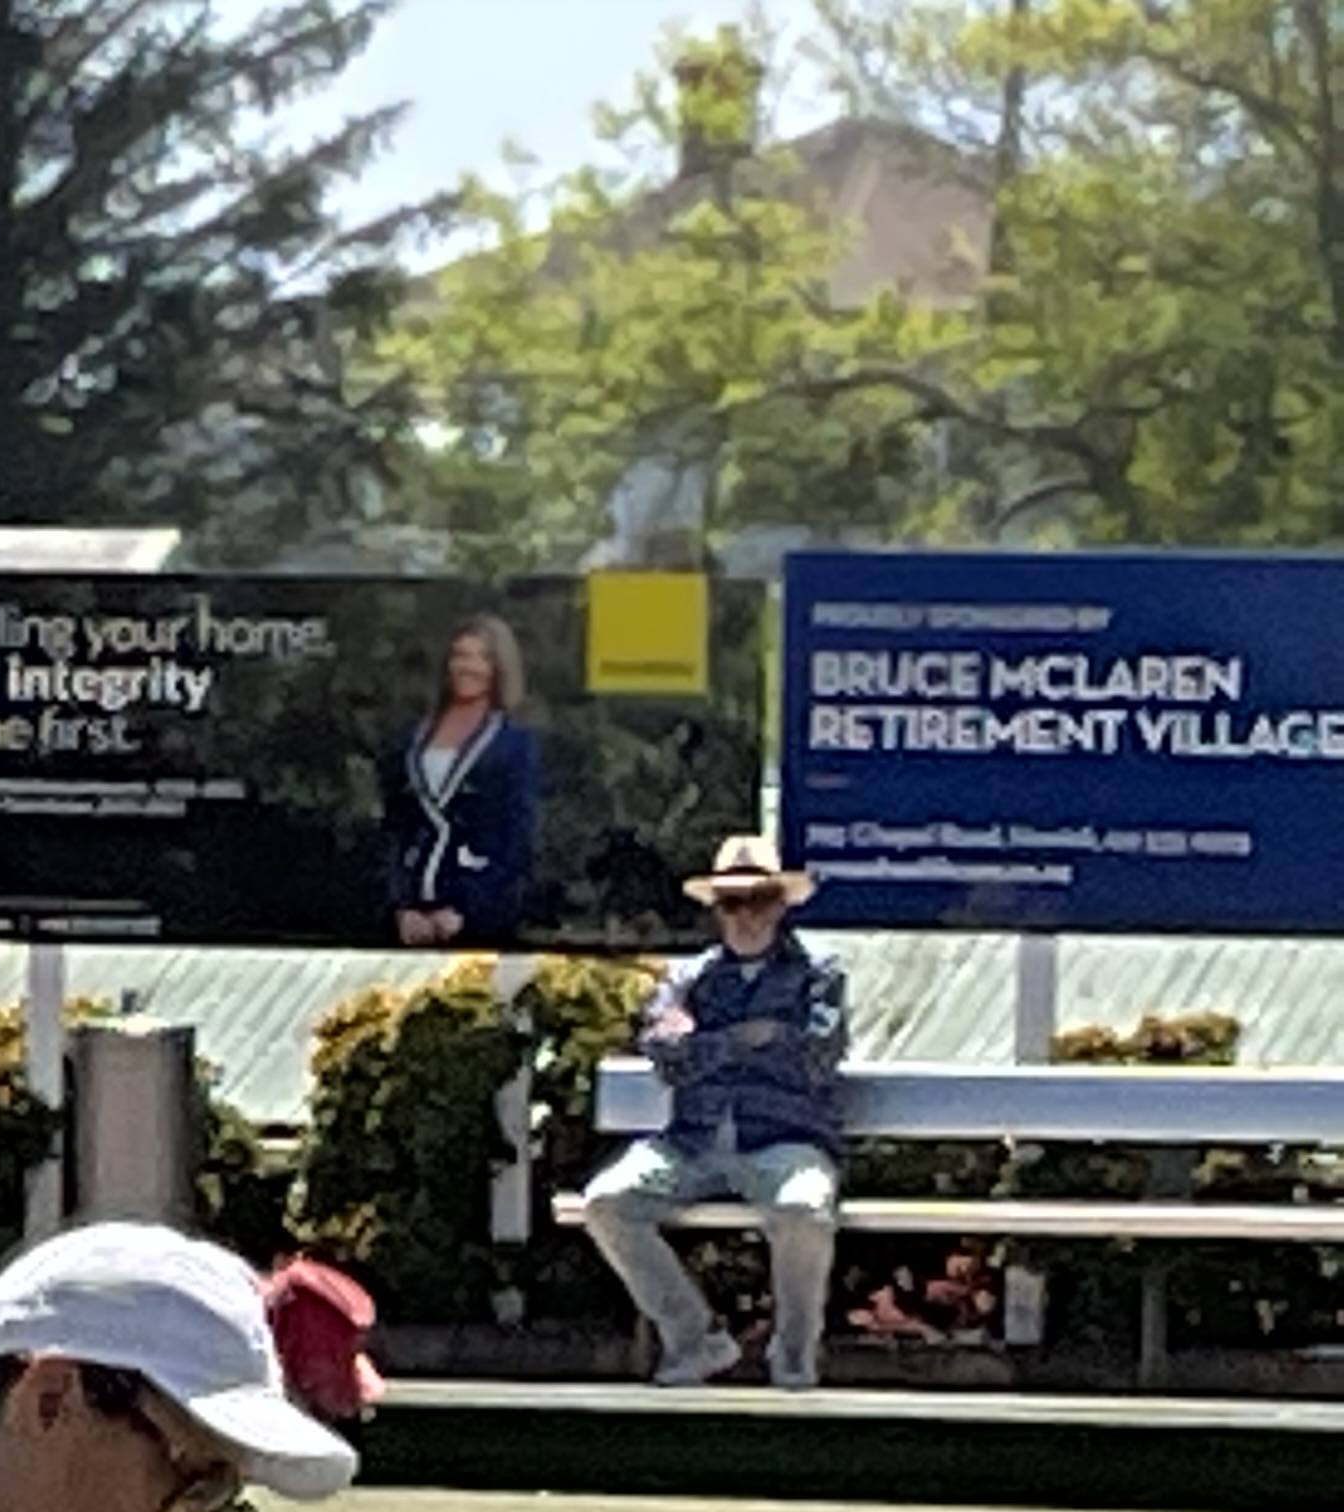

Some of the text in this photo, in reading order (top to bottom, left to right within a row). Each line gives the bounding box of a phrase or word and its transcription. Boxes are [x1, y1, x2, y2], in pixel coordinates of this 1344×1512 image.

[81, 616, 189, 661] your
[7, 653, 210, 712] integrity
[812, 651, 1241, 700] BRUCE MCLAREN
[38, 704, 142, 753] first.
[810, 707, 1344, 758] RETIREMENT VILLAGE
